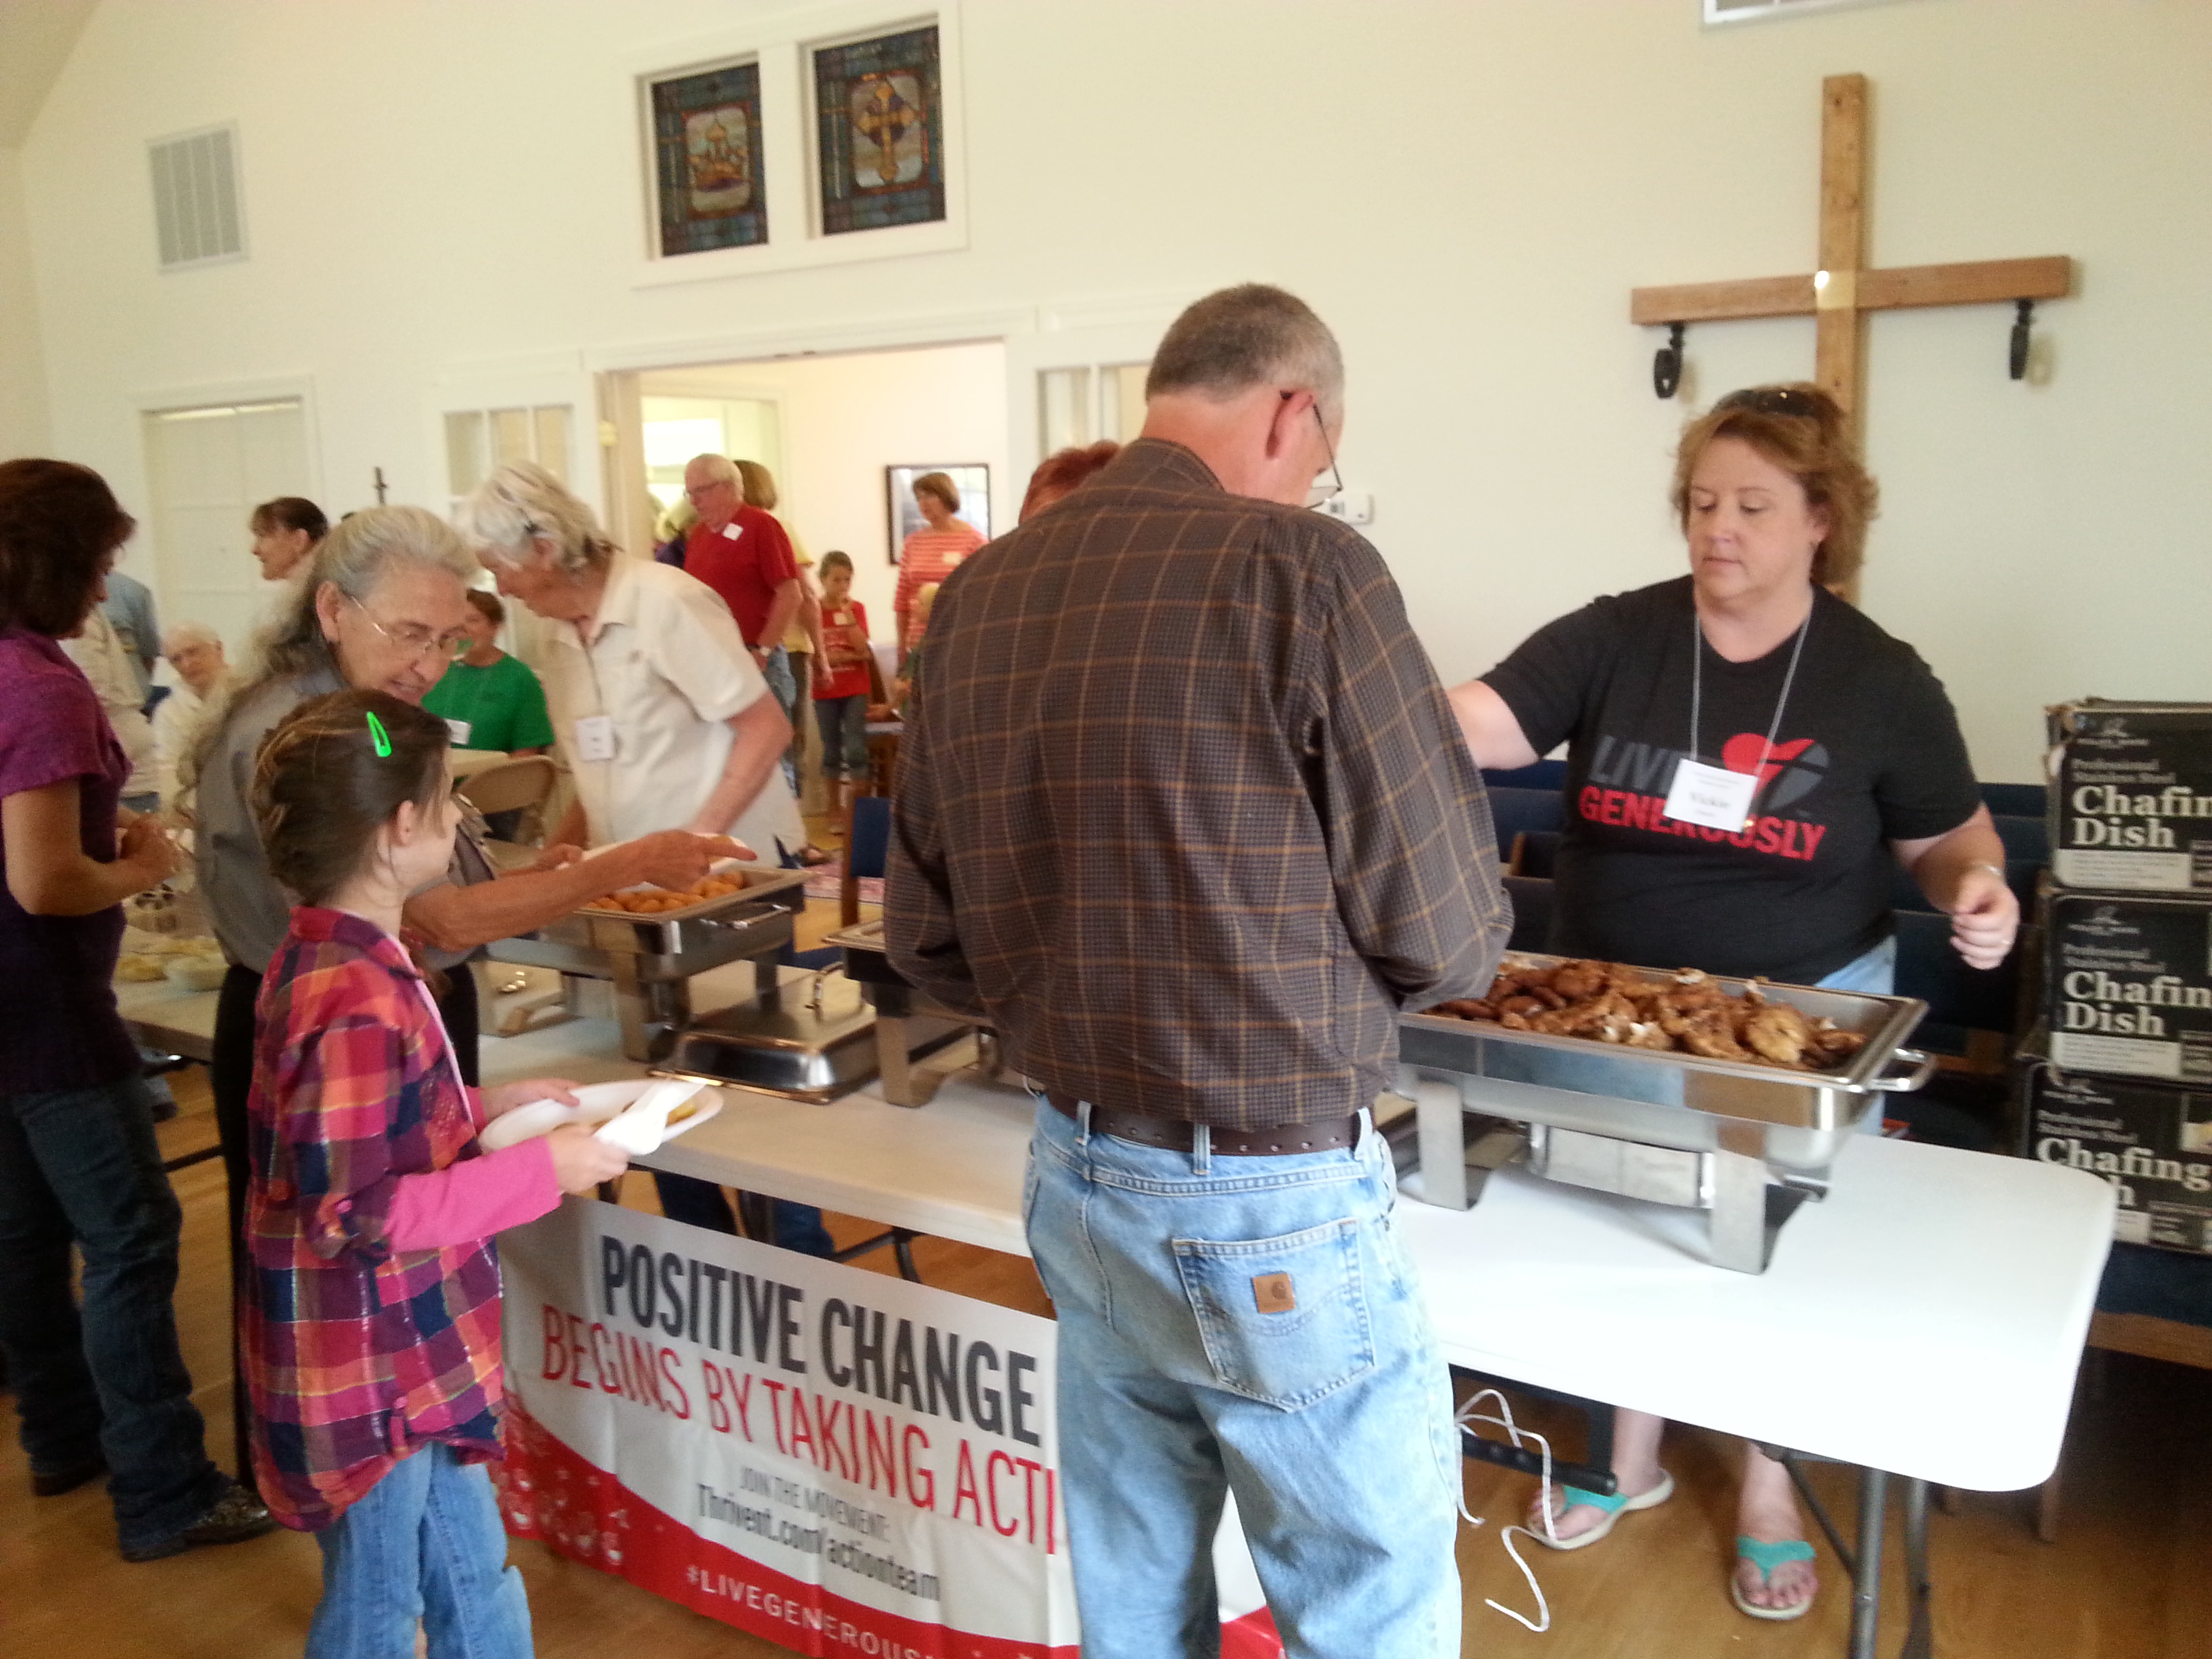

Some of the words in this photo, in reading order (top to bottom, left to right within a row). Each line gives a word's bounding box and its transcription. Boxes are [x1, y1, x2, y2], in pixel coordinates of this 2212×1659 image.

[2072, 785, 2212, 817] Chafin
[2072, 817, 2175, 848] Dish
[2064, 970, 2212, 1008] Chafin
[2064, 1001, 2165, 1036] Dish
[2037, 1137, 2211, 1191] Chafing
[602, 1234, 806, 1374] POSITIVE
[820, 1297, 1042, 1448] CHANGE
[542, 1303, 691, 1420] BEGINS
[702, 1359, 753, 1443] BY
[763, 1378, 935, 1512] TAKING
[954, 1438, 1056, 1555] ACTI
[741, 1467, 773, 1498] JOIN
[775, 1476, 802, 1509] THE
